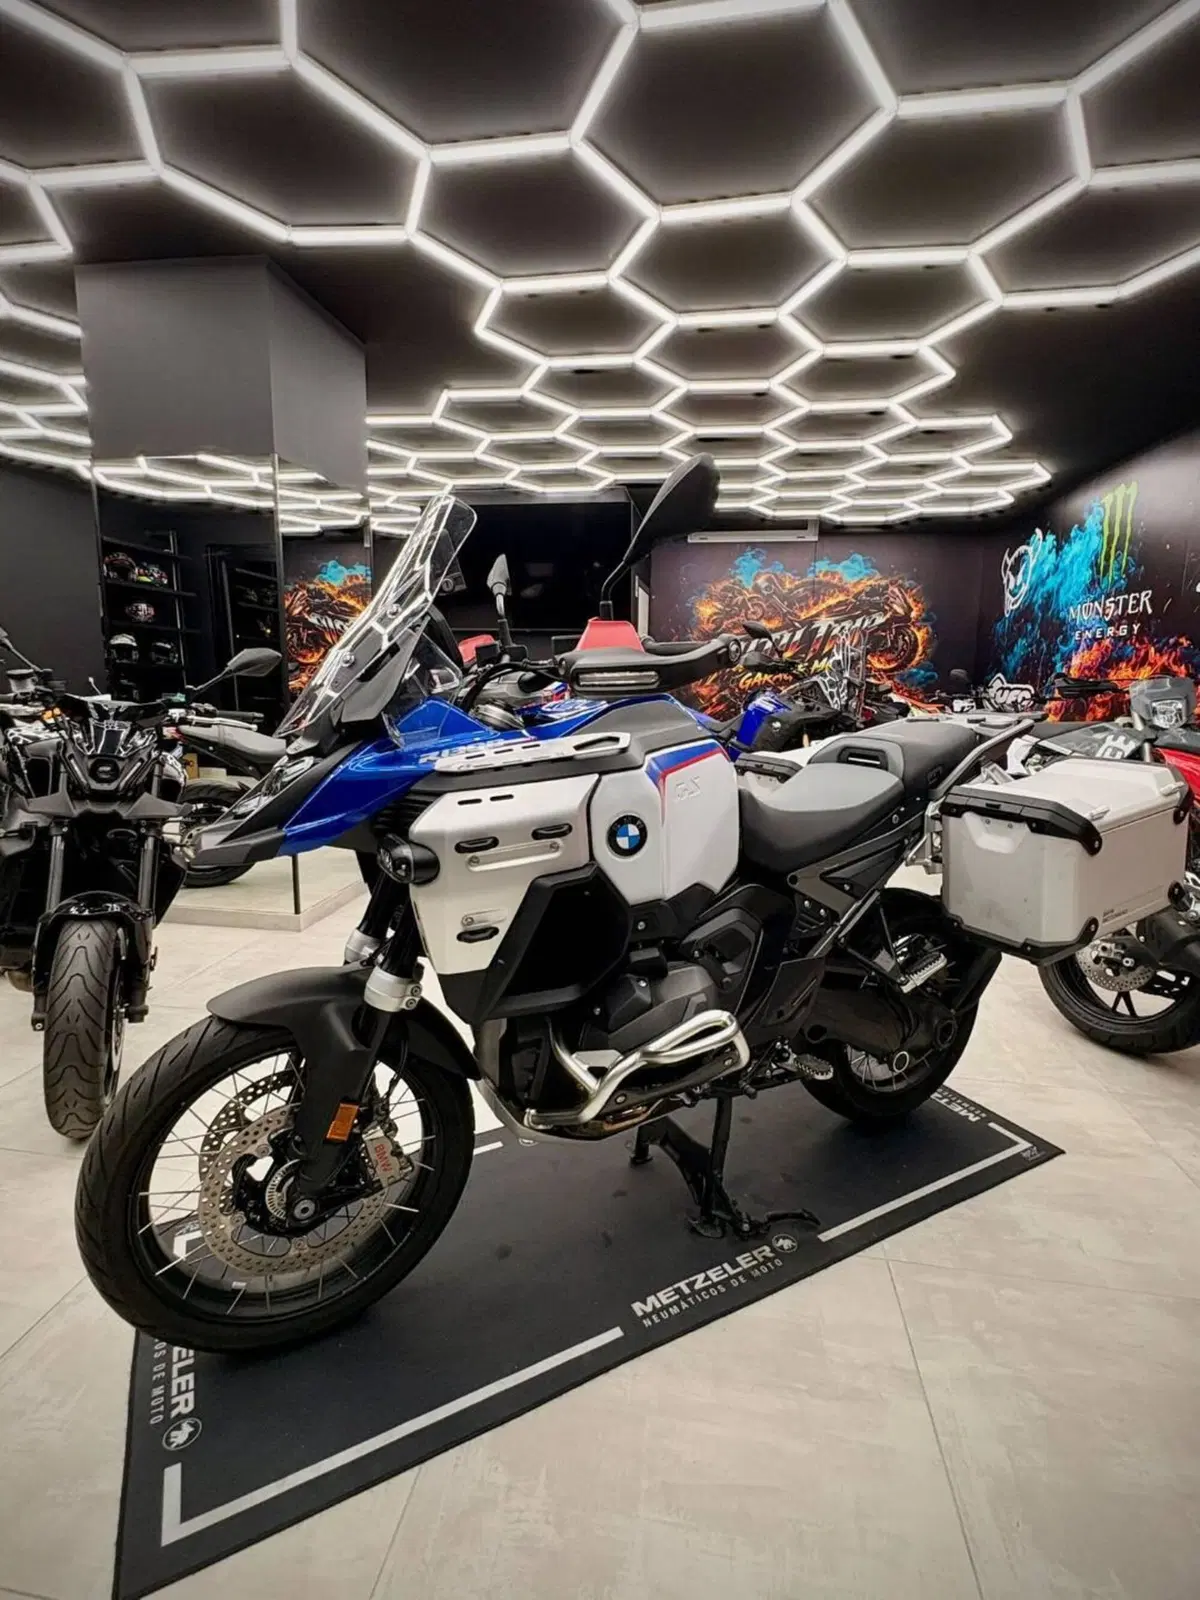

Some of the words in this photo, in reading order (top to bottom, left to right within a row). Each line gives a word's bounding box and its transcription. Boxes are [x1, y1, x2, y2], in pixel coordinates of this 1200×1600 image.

[1069, 590, 1153, 625] MONSTER
[1075, 622, 1141, 640] ENERGY
[375, 1143, 393, 1173] BMW
[630, 1244, 776, 1318] METZELER
[731, 1274, 747, 1288] DE
[751, 1258, 784, 1278] MOTO
[152, 1363, 167, 1381] DE
[150, 1385, 165, 1425] MOTO
